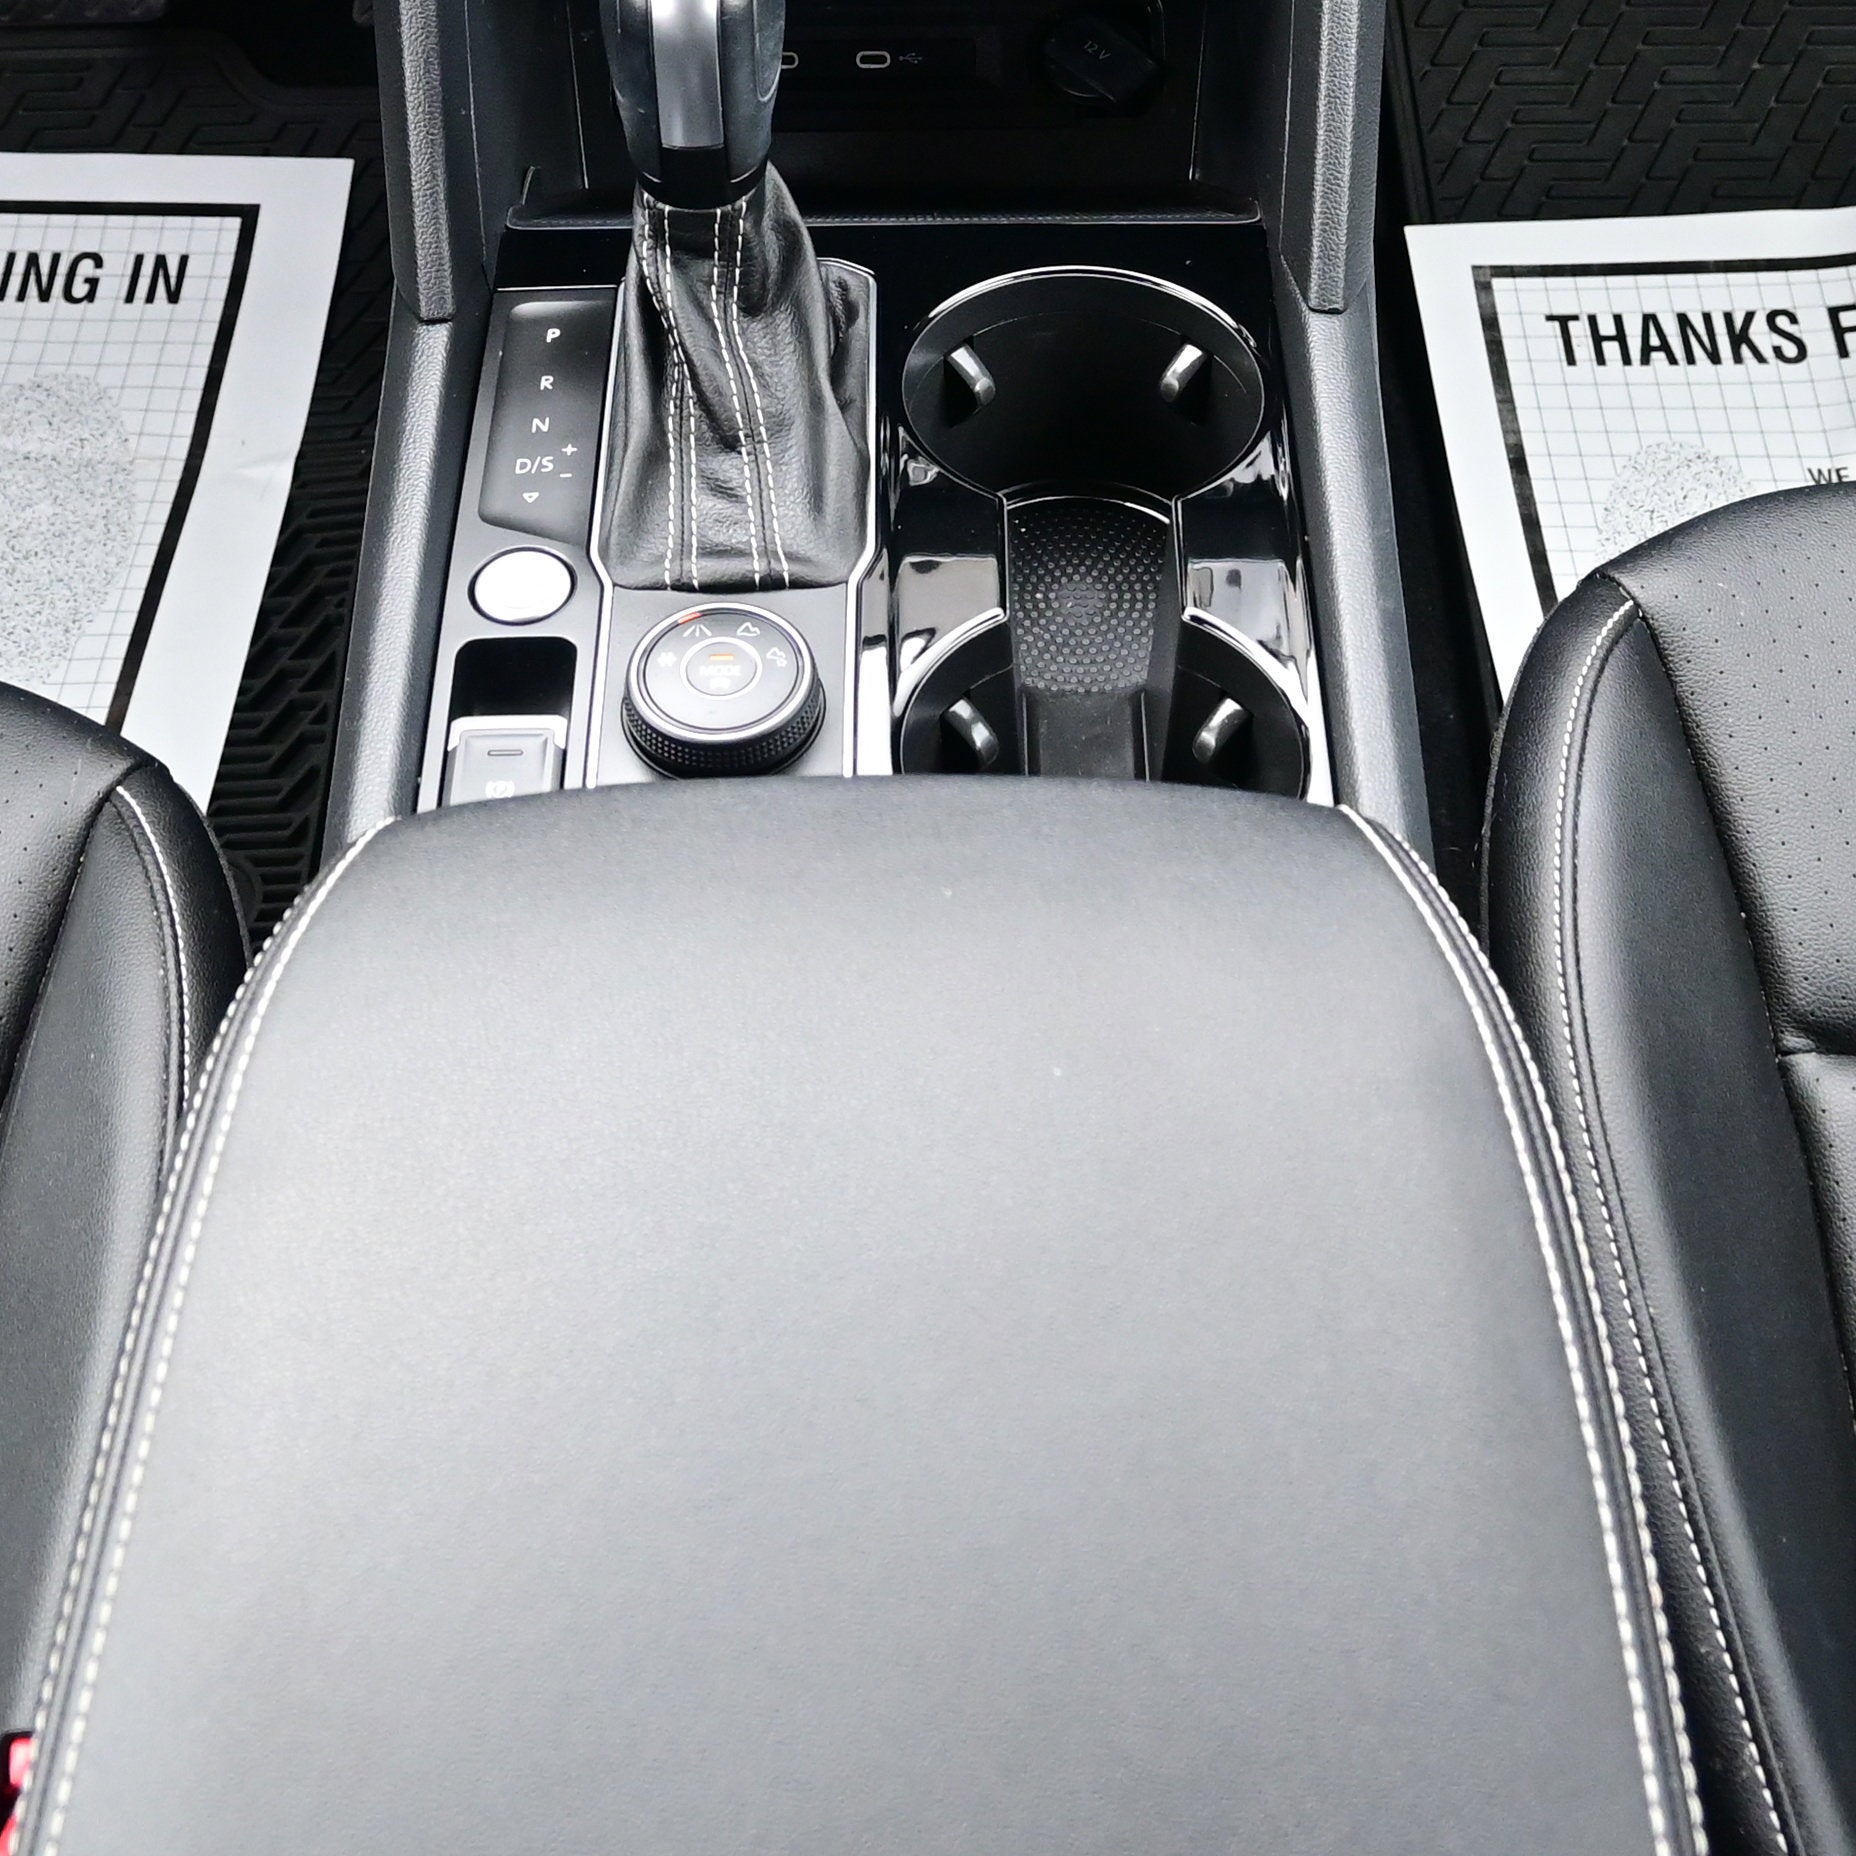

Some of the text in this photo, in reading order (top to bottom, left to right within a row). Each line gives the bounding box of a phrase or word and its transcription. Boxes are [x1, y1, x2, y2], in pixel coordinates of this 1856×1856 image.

[124, 254, 189, 304] IN
[546, 328, 561, 343] P
[1544, 308, 1807, 366] THANKS
[540, 375, 554, 390] R
[531, 417, 549, 433] N
[515, 456, 554, 474] D/S
[700, 665, 741, 676] MODE
